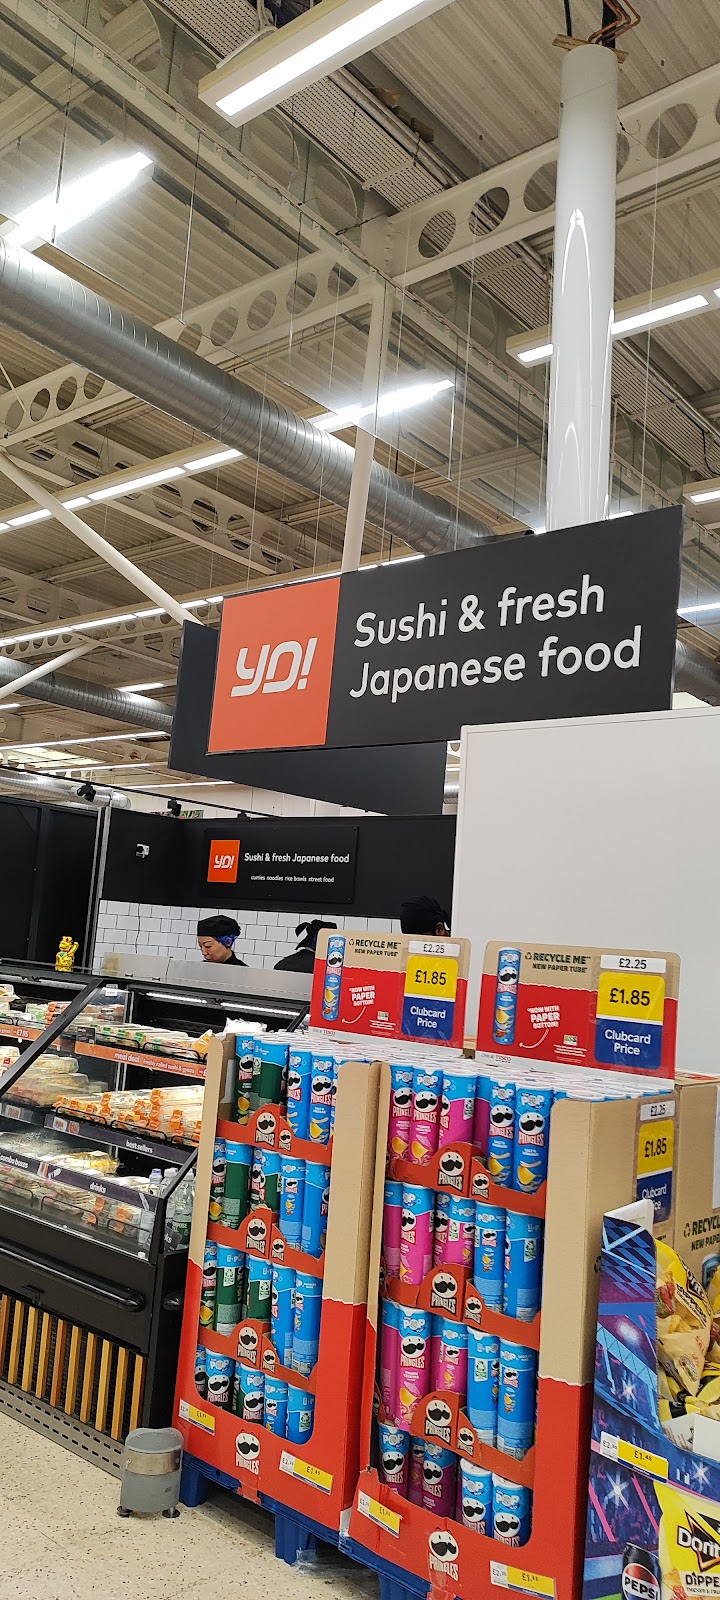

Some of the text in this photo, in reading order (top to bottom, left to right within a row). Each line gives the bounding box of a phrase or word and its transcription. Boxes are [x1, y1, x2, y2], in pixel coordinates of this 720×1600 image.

[353, 574, 605, 648] Sushi & fresh
[231, 638, 318, 697] YO!
[349, 625, 642, 703] Japanese food
[214, 855, 235, 869] YO!
[244, 853, 350, 864] Sushi & fresh Japanese food
[356, 939, 385, 949] RECYCLE
[423, 944, 445, 954] £2.25
[533, 953, 570, 963] RECYCLE
[619, 958, 647, 970] £2.25
[548, 964, 568, 973] PAPER
[415, 970, 447, 985] £1.85
[352, 992, 375, 1001] PAPER
[609, 988, 650, 1006] £1.85
[410, 1006, 447, 1019] Clubcard
[531, 1012, 560, 1023] PAPER
[417, 1018, 438, 1029] Price
[605, 1029, 651, 1045] Clubcard
[614, 1043, 641, 1056] Price
[114, 1053, 128, 1061] meal
[128, 1054, 141, 1063] deal
[417, 1076, 439, 1086] POP
[521, 1095, 545, 1106] POP
[414, 1110, 438, 1123] PRINGLES
[650, 1104, 666, 1117] £2.25
[256, 1128, 275, 1146] PRINGLES
[518, 1130, 545, 1147] PRINGLES
[126, 1140, 154, 1154] best sellers
[645, 1138, 667, 1158] £1.85
[438, 1169, 463, 1192] PRINGLES
[90, 1182, 107, 1194] drinks
[642, 1184, 667, 1200] Clubcard
[246, 1236, 266, 1255] PRINGLES
[691, 1238, 705, 1251] NEW
[431, 1292, 457, 1314] PRINGLES
[403, 1318, 426, 1330] POP
[238, 1344, 257, 1365] PRINGLES
[400, 1356, 425, 1369] PRINGLES
[425, 1420, 452, 1444] PRINGLES
[383, 1433, 404, 1446] POP
[236, 1452, 260, 1475] PRINGLES
[496, 1492, 520, 1507] POP
[429, 1557, 459, 1582] PRINGLES
